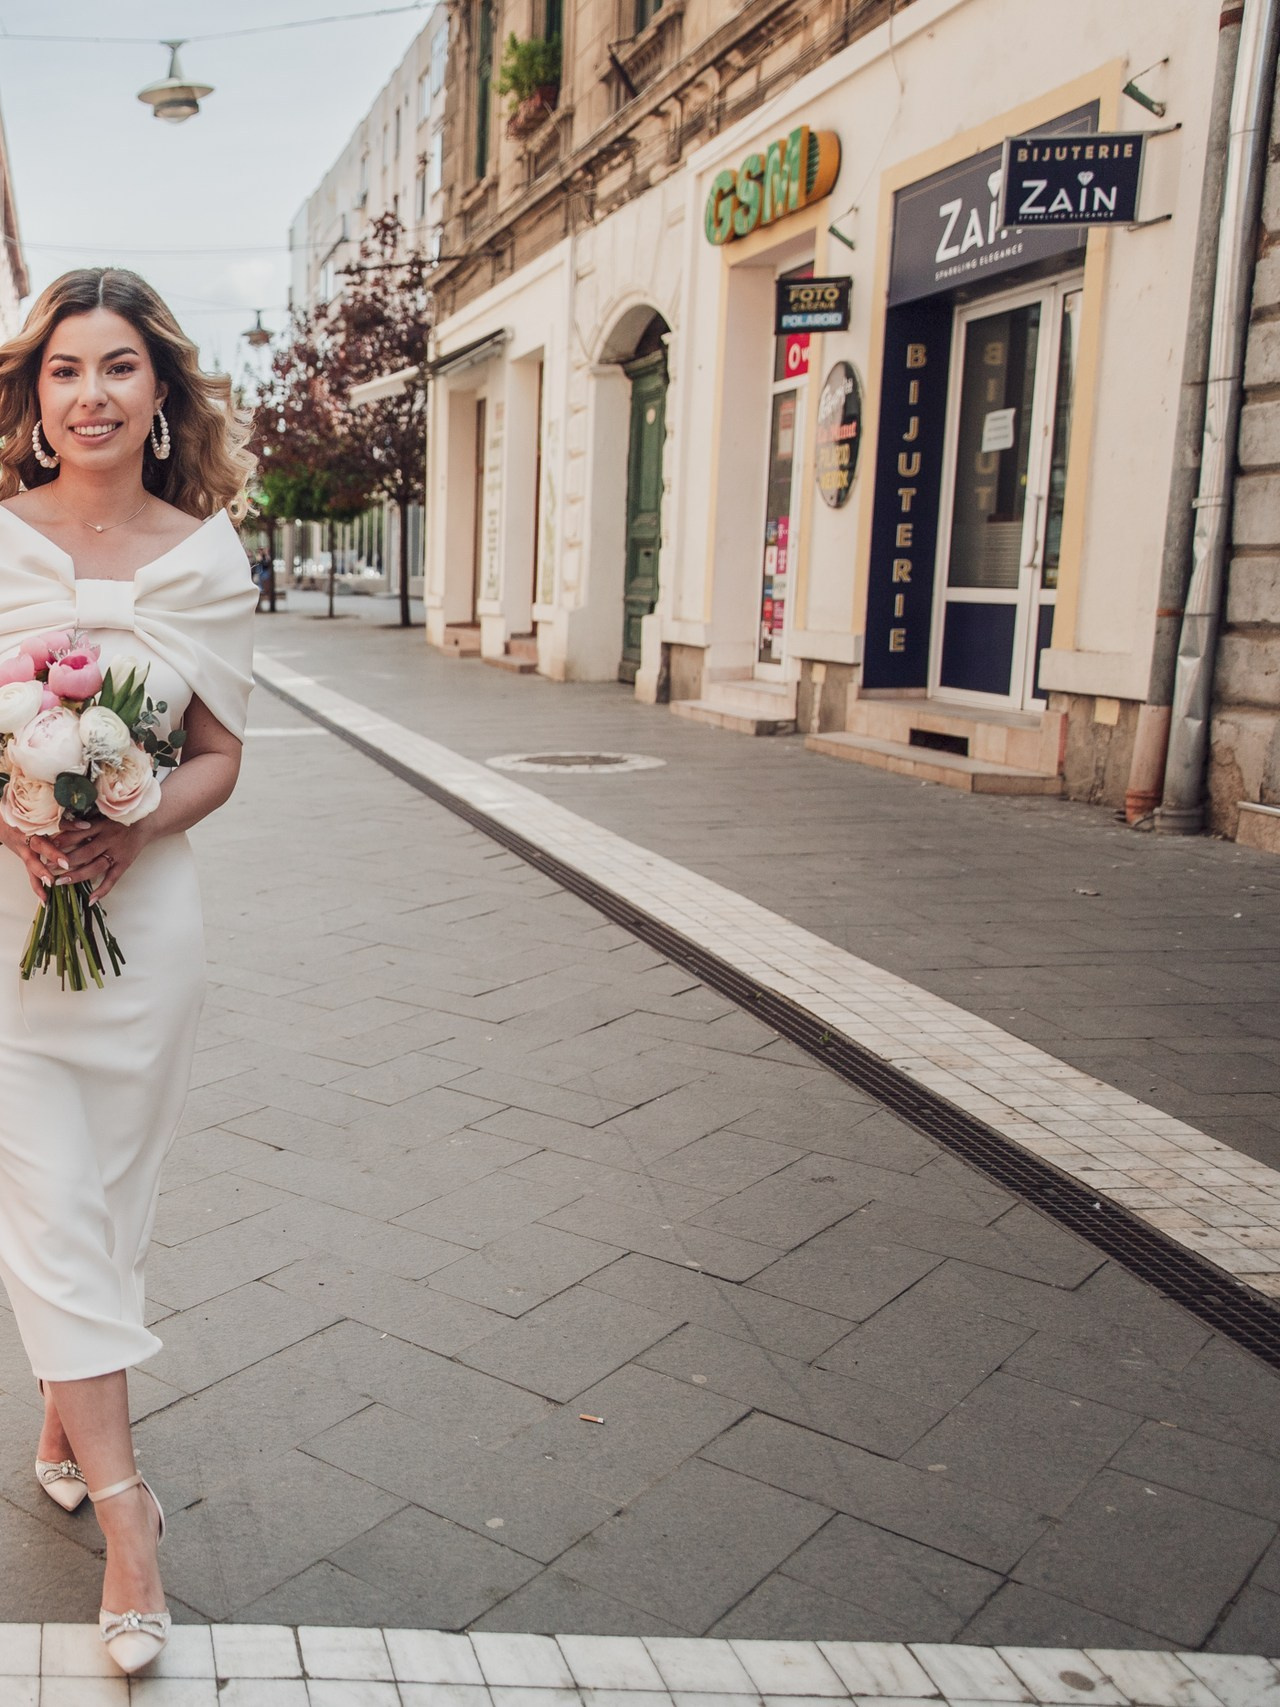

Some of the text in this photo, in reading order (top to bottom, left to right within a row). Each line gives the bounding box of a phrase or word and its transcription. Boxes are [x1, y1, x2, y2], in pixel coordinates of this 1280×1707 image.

[1017, 144, 1134, 163] BIJUTERIE
[705, 124, 810, 246] GSM
[935, 197, 1023, 263] ZAI
[979, 242, 1023, 266] ELEGANCE
[789, 287, 840, 304] FOTO
[782, 312, 843, 329] POLAROID
[889, 343, 927, 653] BIJUTERIE
